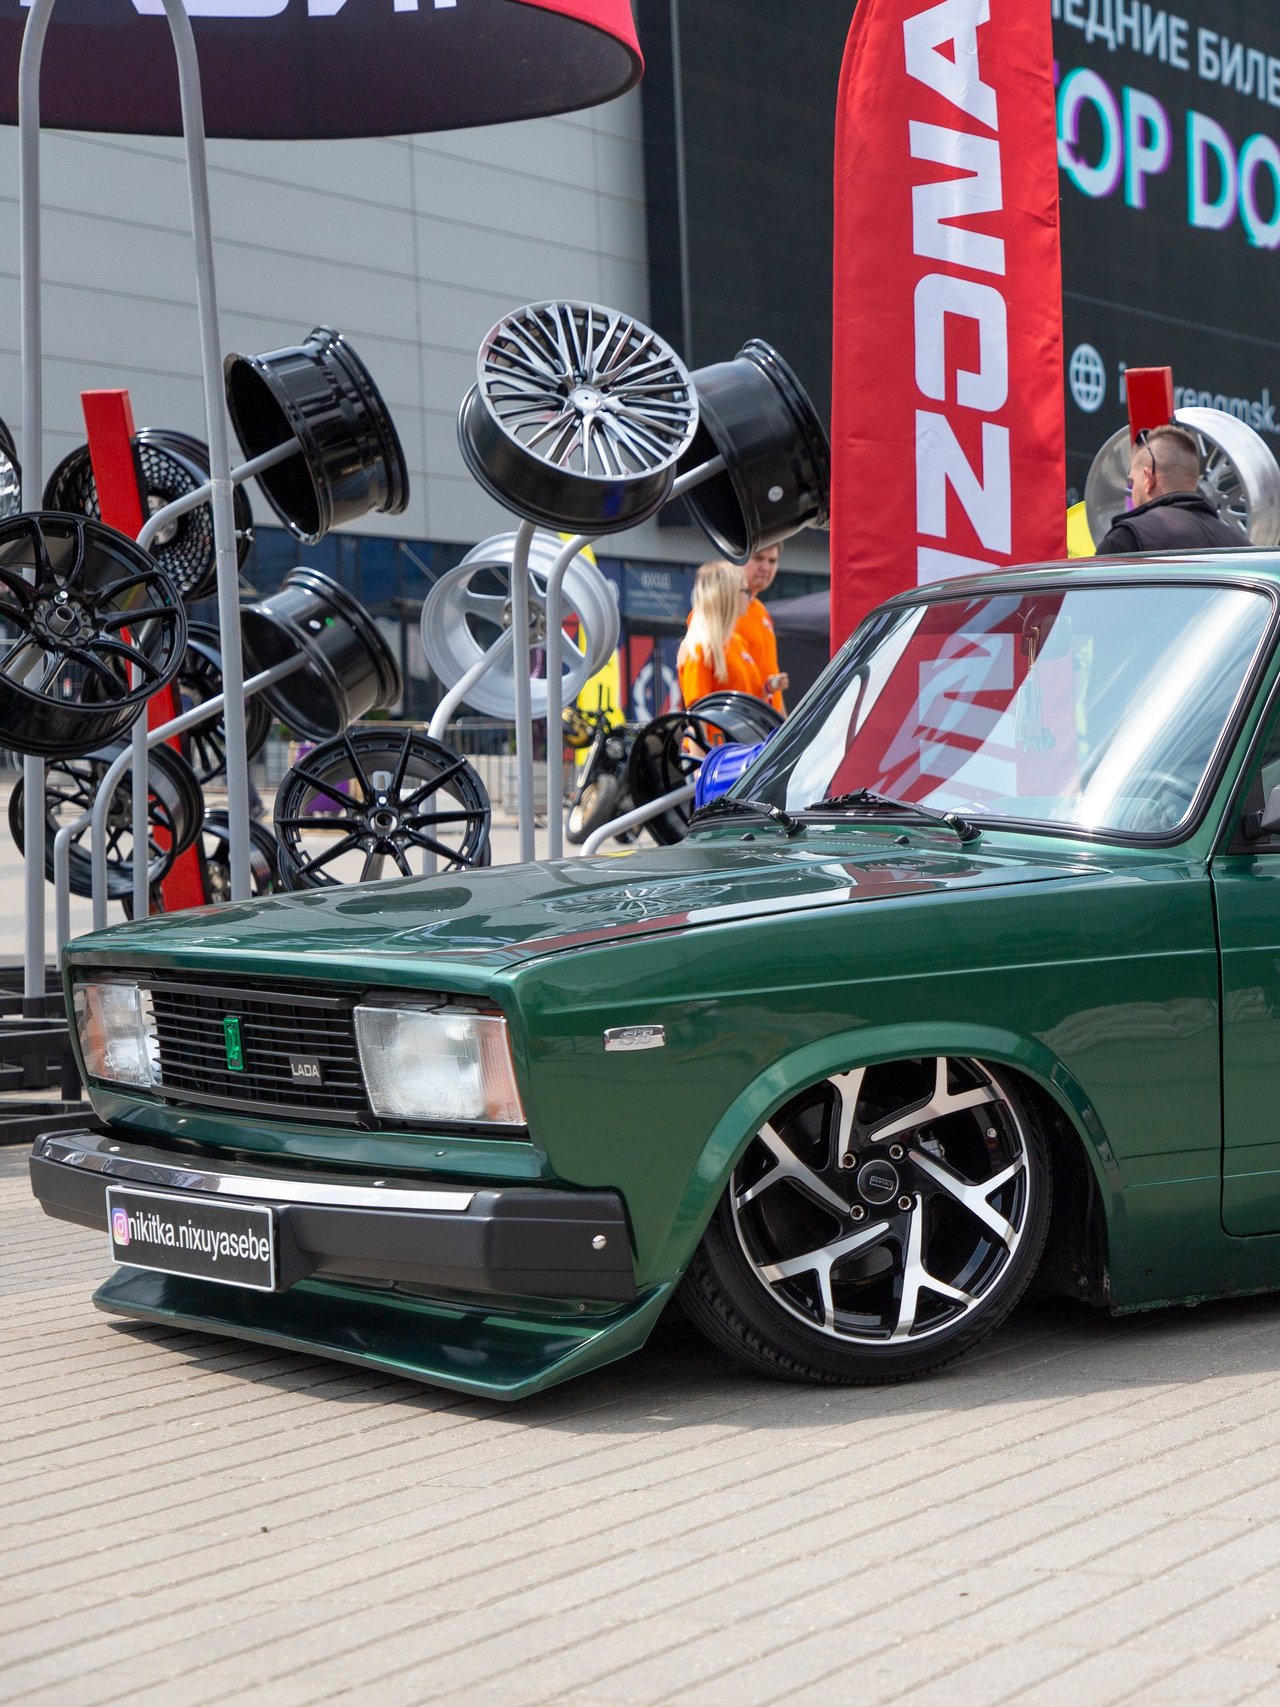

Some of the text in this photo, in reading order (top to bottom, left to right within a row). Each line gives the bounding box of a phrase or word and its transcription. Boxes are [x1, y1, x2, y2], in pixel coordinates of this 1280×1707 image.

[1053, 60, 1172, 210] OP
[291, 1063, 320, 1078] LADA
[127, 1211, 270, 1262] nikitka.nixuyasebe
